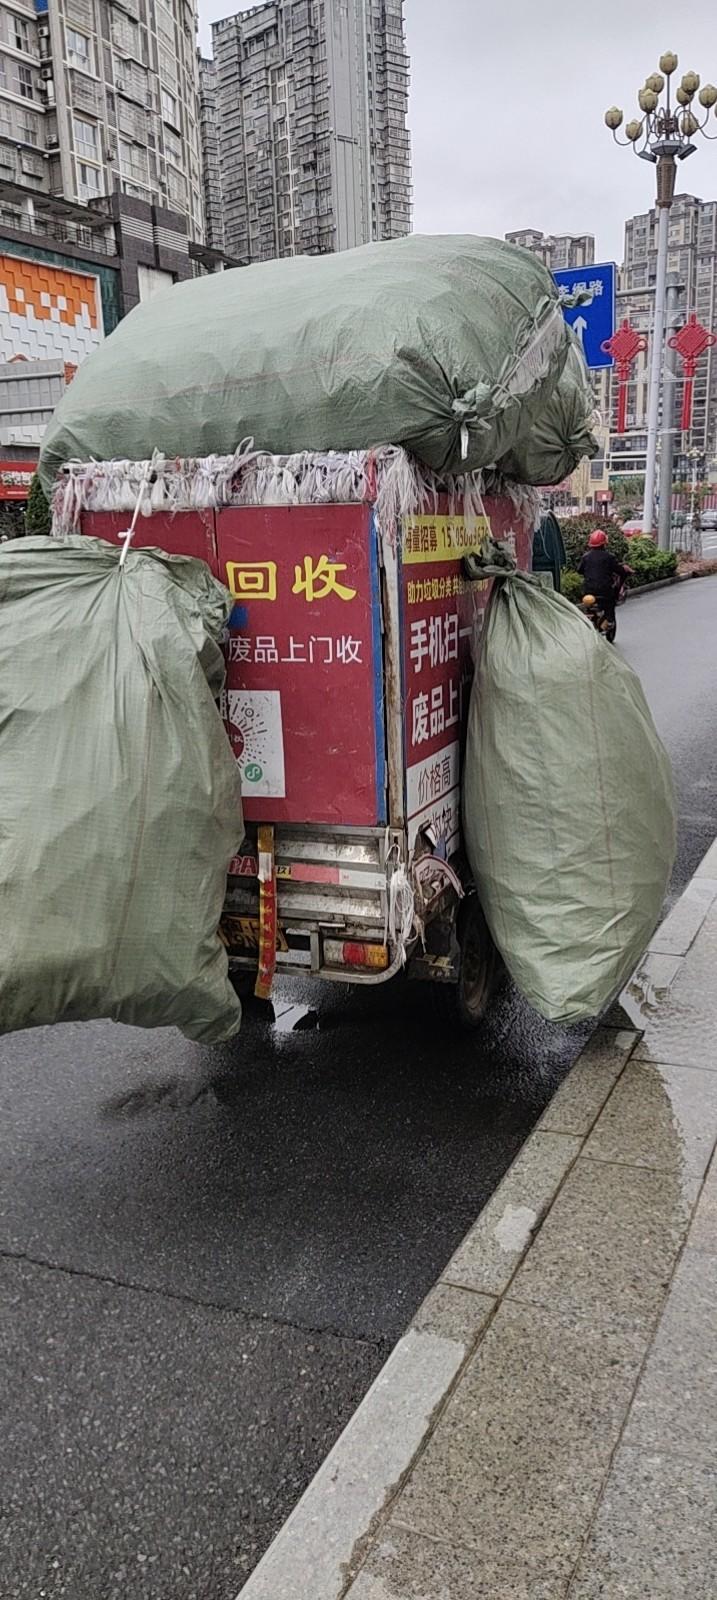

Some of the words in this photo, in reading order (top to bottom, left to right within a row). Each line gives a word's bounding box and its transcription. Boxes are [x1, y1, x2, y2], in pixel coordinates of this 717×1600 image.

[226, 555, 357, 602] 回收
[228, 635, 363, 664] 废品上门收
[417, 755, 452, 806] 价格高
